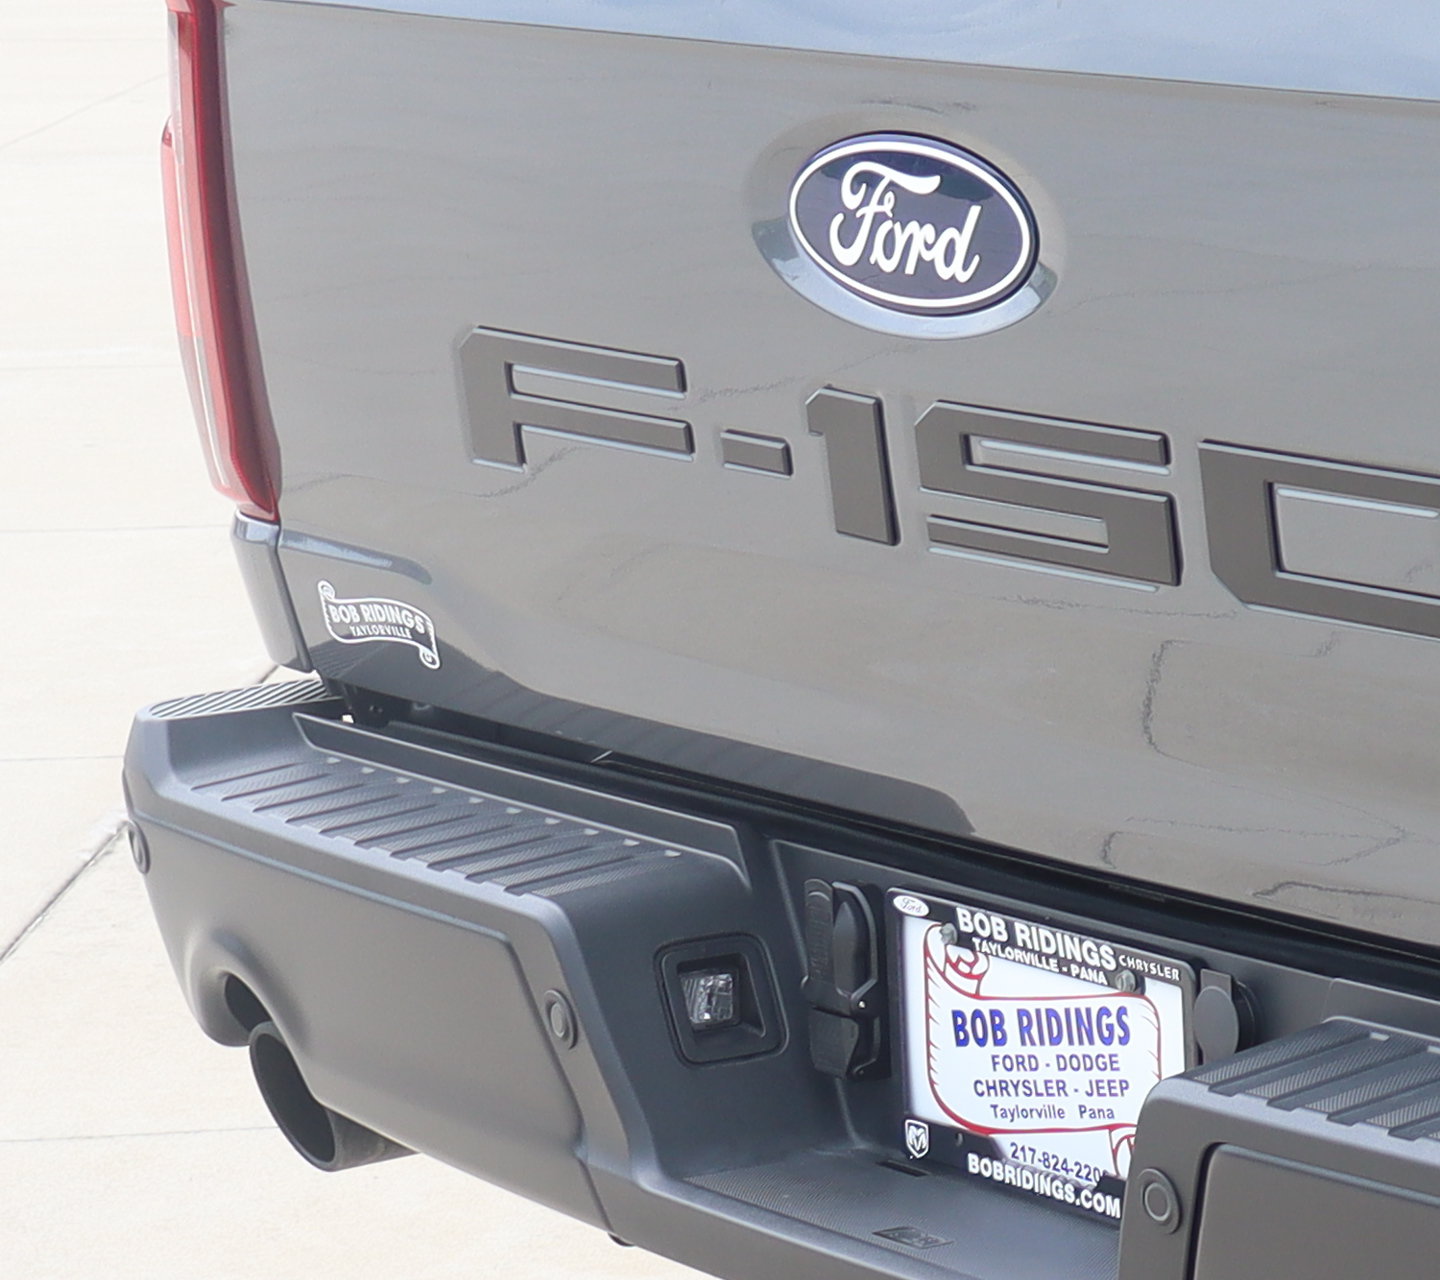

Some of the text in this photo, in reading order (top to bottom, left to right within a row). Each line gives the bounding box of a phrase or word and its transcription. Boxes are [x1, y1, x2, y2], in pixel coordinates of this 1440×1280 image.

[829, 160, 982, 283] Ford
[328, 604, 425, 634] BOB RIDINGS
[349, 624, 412, 639] TAYLORVILLE
[900, 896, 922, 914] Ford
[955, 906, 1117, 971] BOB RIDINGS
[971, 936, 1060, 973] TAYLORVILLE
[1070, 963, 1108, 986] PANA
[1118, 954, 1180, 981] CHRYSLER
[951, 1005, 1131, 1048] BOB RIDINGS
[991, 1054, 1040, 1072] FORD
[1055, 1053, 1121, 1072] DODGE
[973, 1079, 1069, 1098] CHRYSLER
[1085, 1079, 1130, 1098] JEEP
[990, 1104, 1115, 1123] Taylorville Pana
[1010, 1141, 1107, 1183] 217-824-220
[967, 1152, 1121, 1219] BOBRIDINGS.COM
